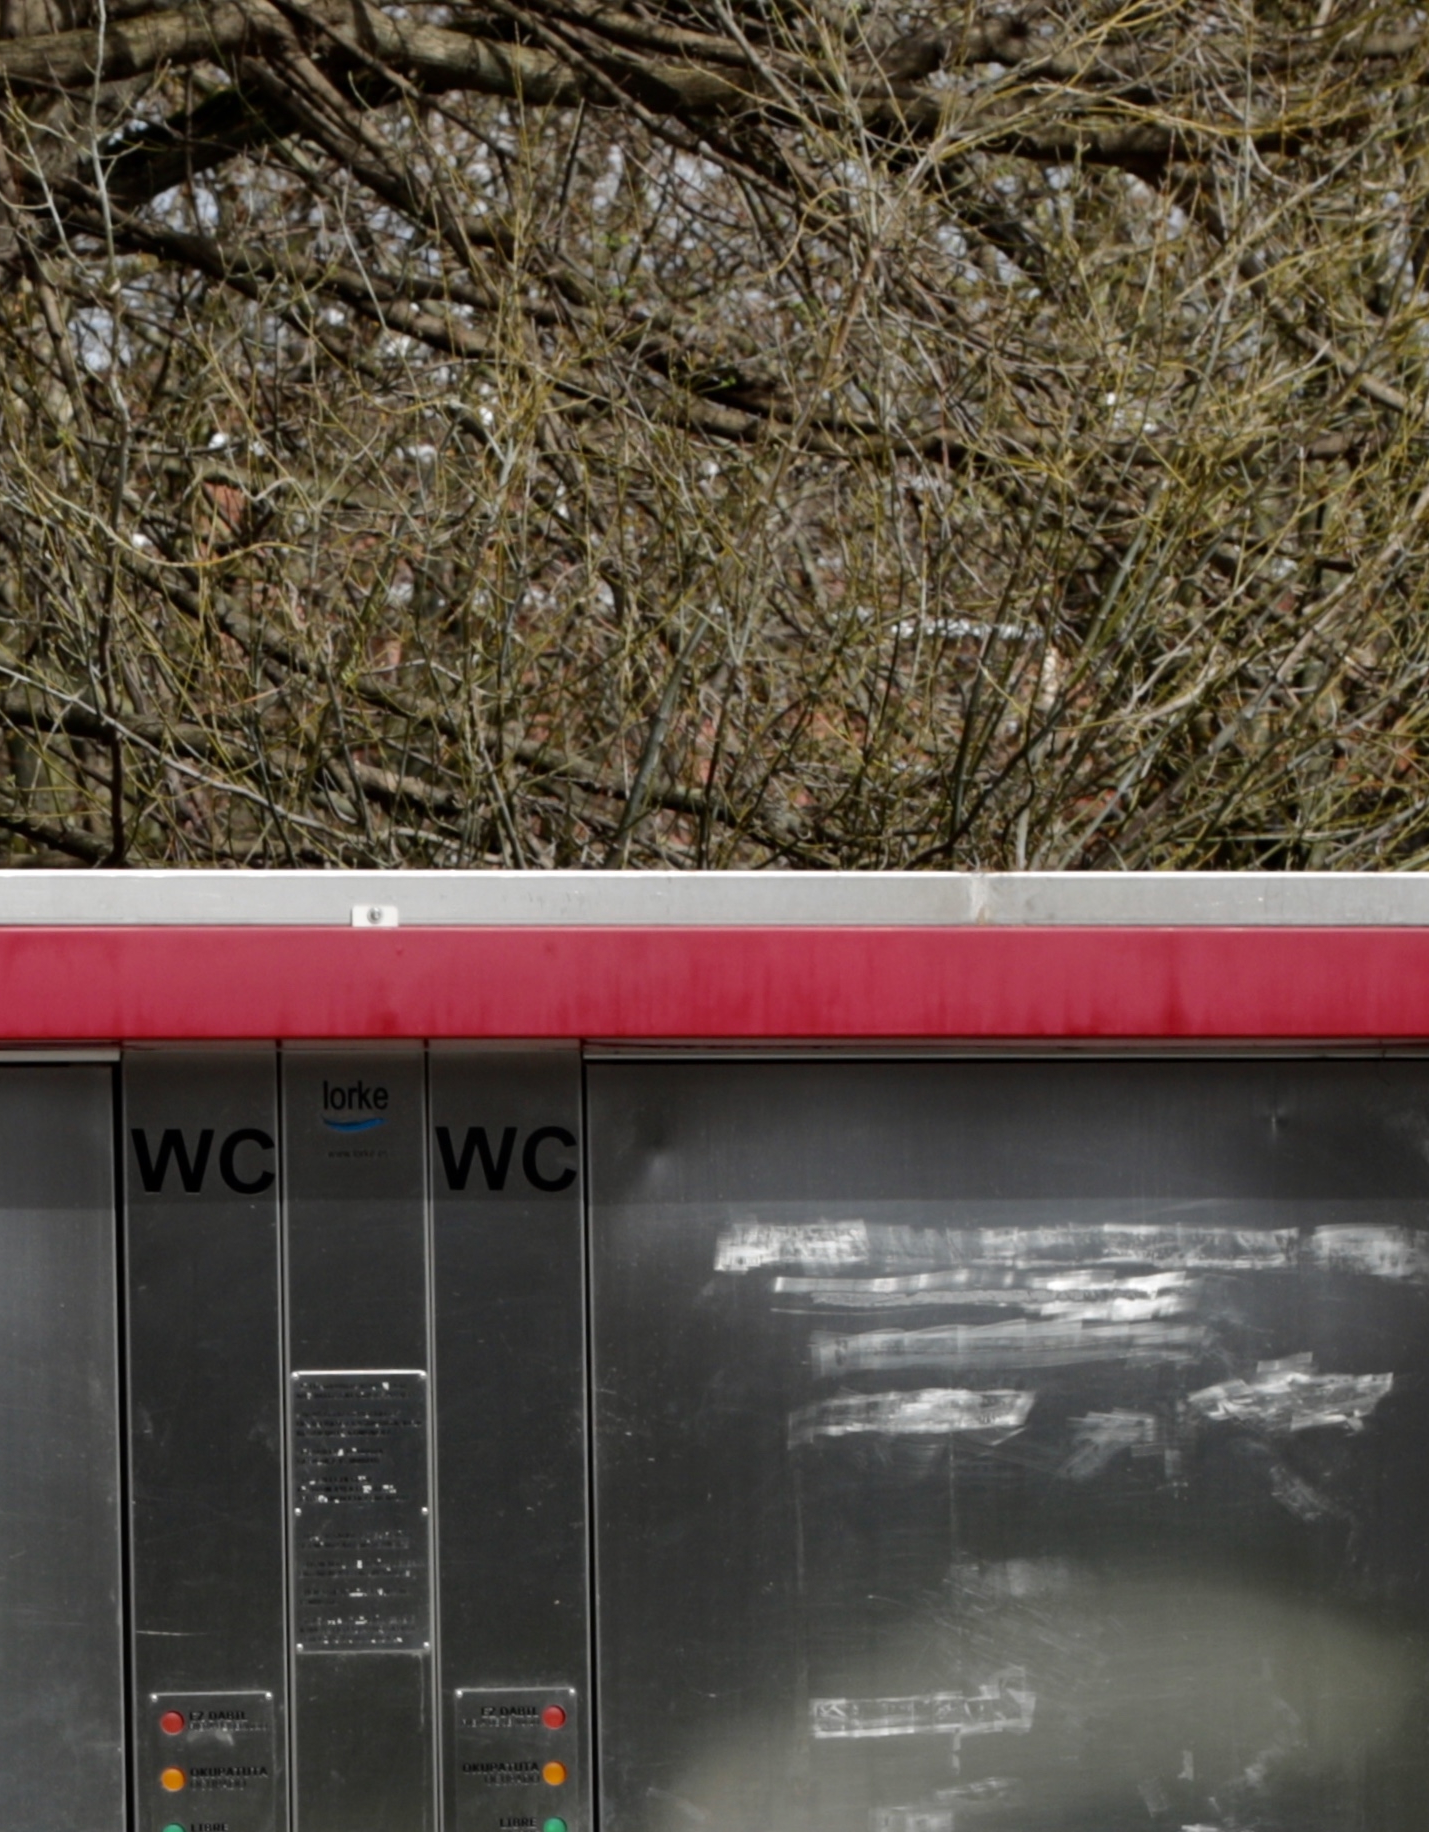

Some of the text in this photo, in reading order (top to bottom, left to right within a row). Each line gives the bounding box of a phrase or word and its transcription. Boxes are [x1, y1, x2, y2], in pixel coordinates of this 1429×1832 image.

[322, 1079, 389, 1111] lorke
[131, 1128, 276, 1194] WC
[434, 1126, 579, 1192] WC
